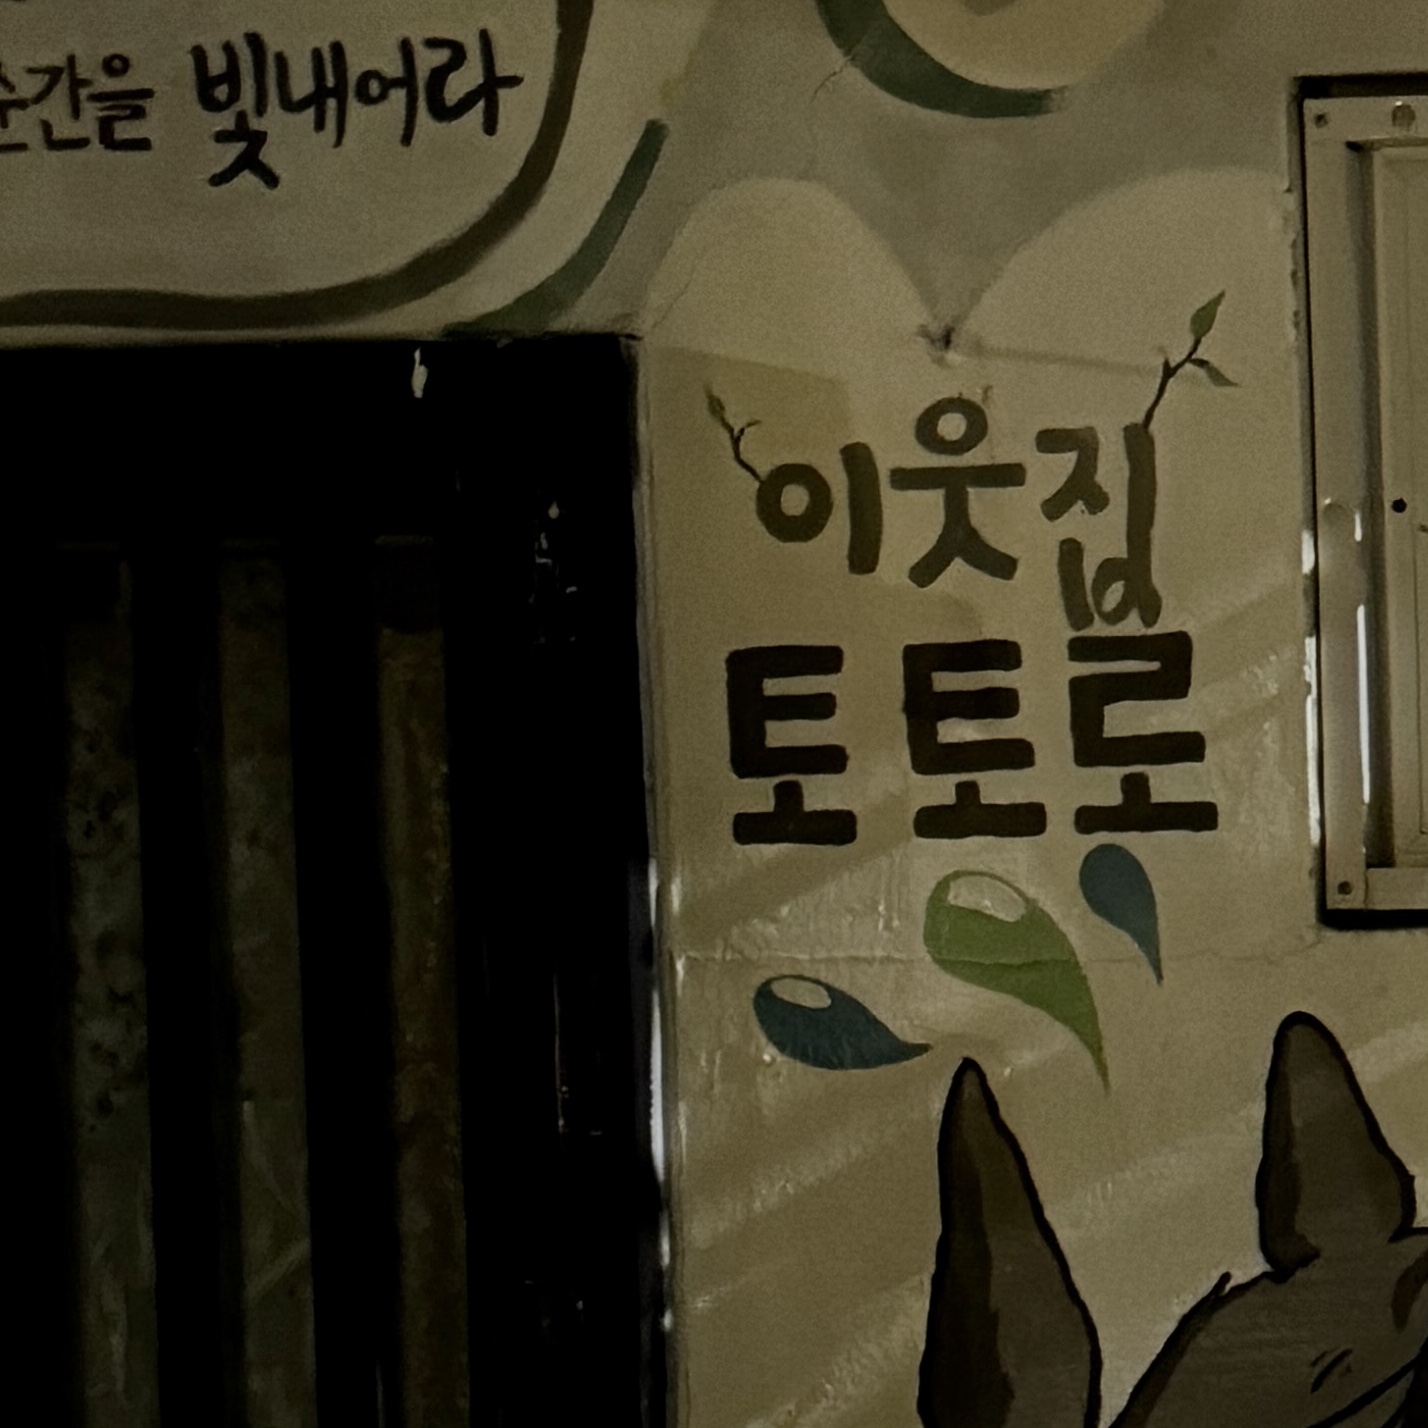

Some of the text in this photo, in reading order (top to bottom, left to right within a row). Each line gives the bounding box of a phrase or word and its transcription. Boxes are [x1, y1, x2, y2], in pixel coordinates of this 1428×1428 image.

[189, 28, 524, 190] 빛내어라
[756, 393, 1162, 631] 이웃집
[725, 629, 1219, 846] 토토로
